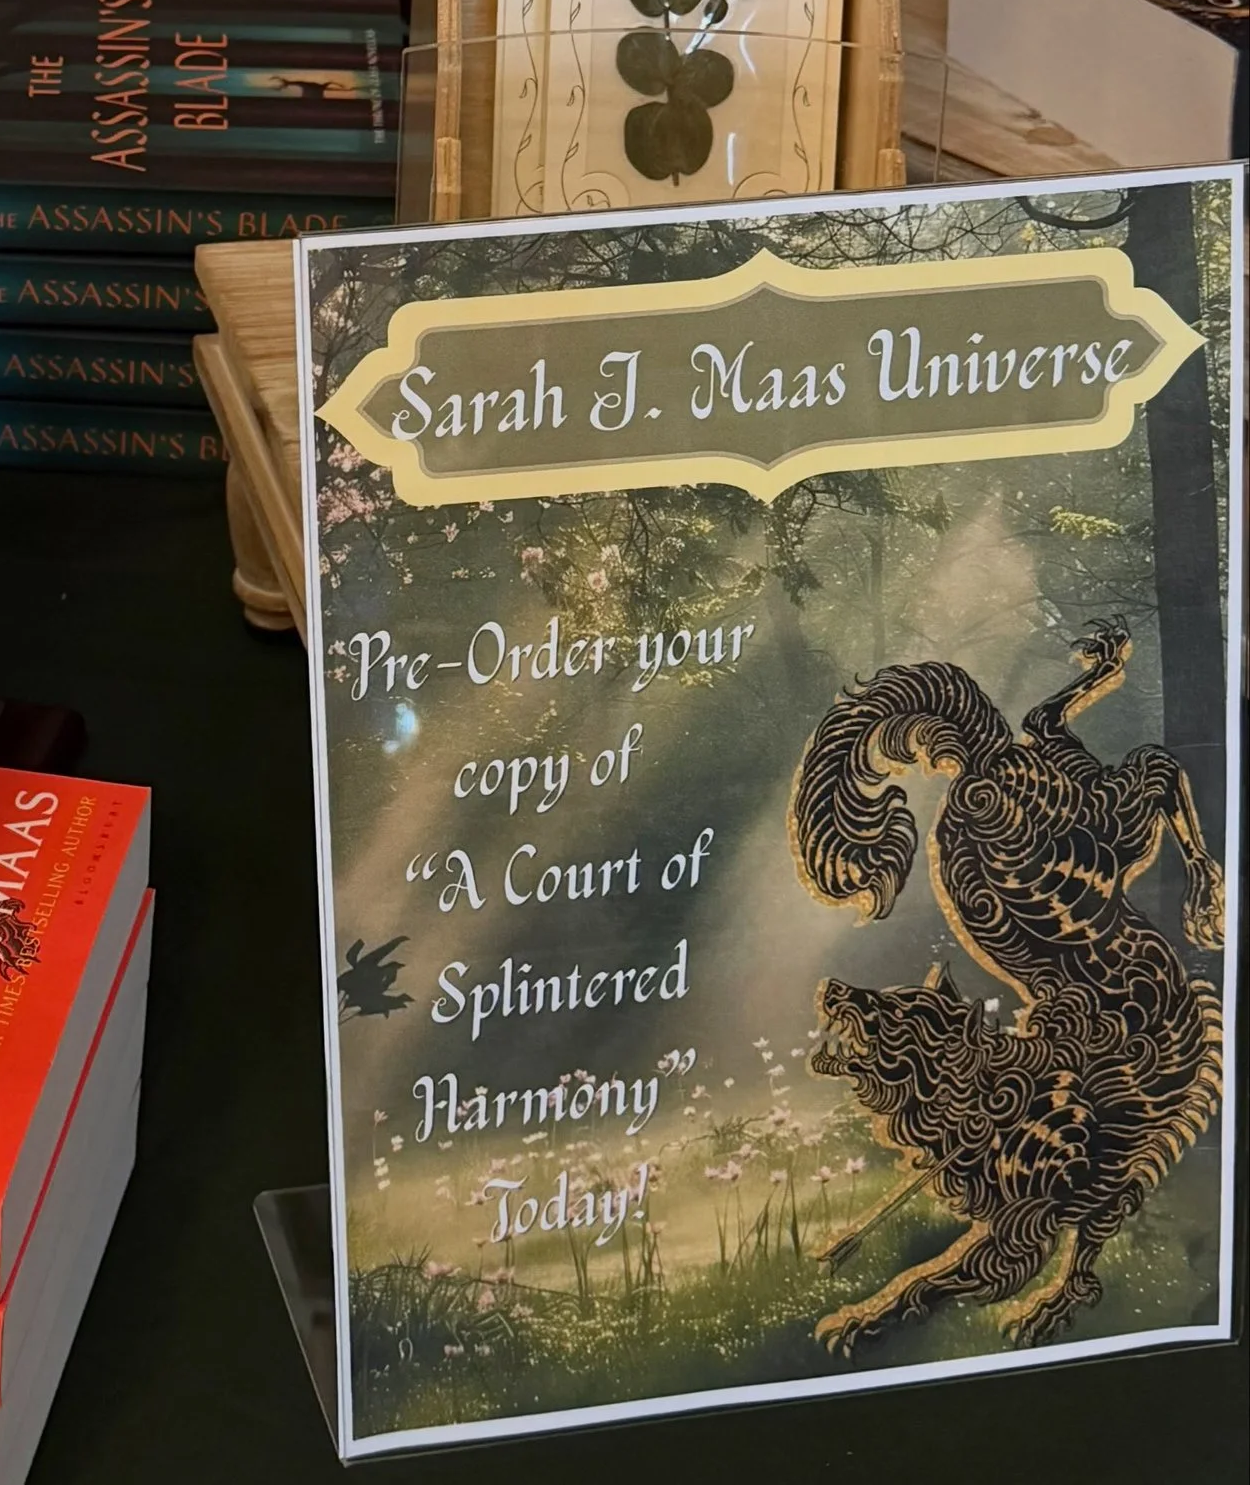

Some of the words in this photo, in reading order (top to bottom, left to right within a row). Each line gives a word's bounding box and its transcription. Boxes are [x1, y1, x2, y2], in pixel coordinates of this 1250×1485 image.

[28, 55, 64, 97] THE
[174, 31, 228, 131] BLADE
[28, 204, 223, 236] ASSASSIN'S
[391, 358, 568, 443] Sarah
[588, 349, 660, 433] J.
[691, 341, 847, 421] Maas
[867, 327, 1134, 403] Universe
[349, 616, 617, 701] Pre-Order
[632, 621, 755, 693] your
[453, 751, 570, 815] copy
[589, 723, 644, 787] of
[504, 844, 642, 906] Court
[661, 828, 715, 892] of
[430, 938, 691, 1042] Splintered
[481, 1163, 650, 1248] Today!
